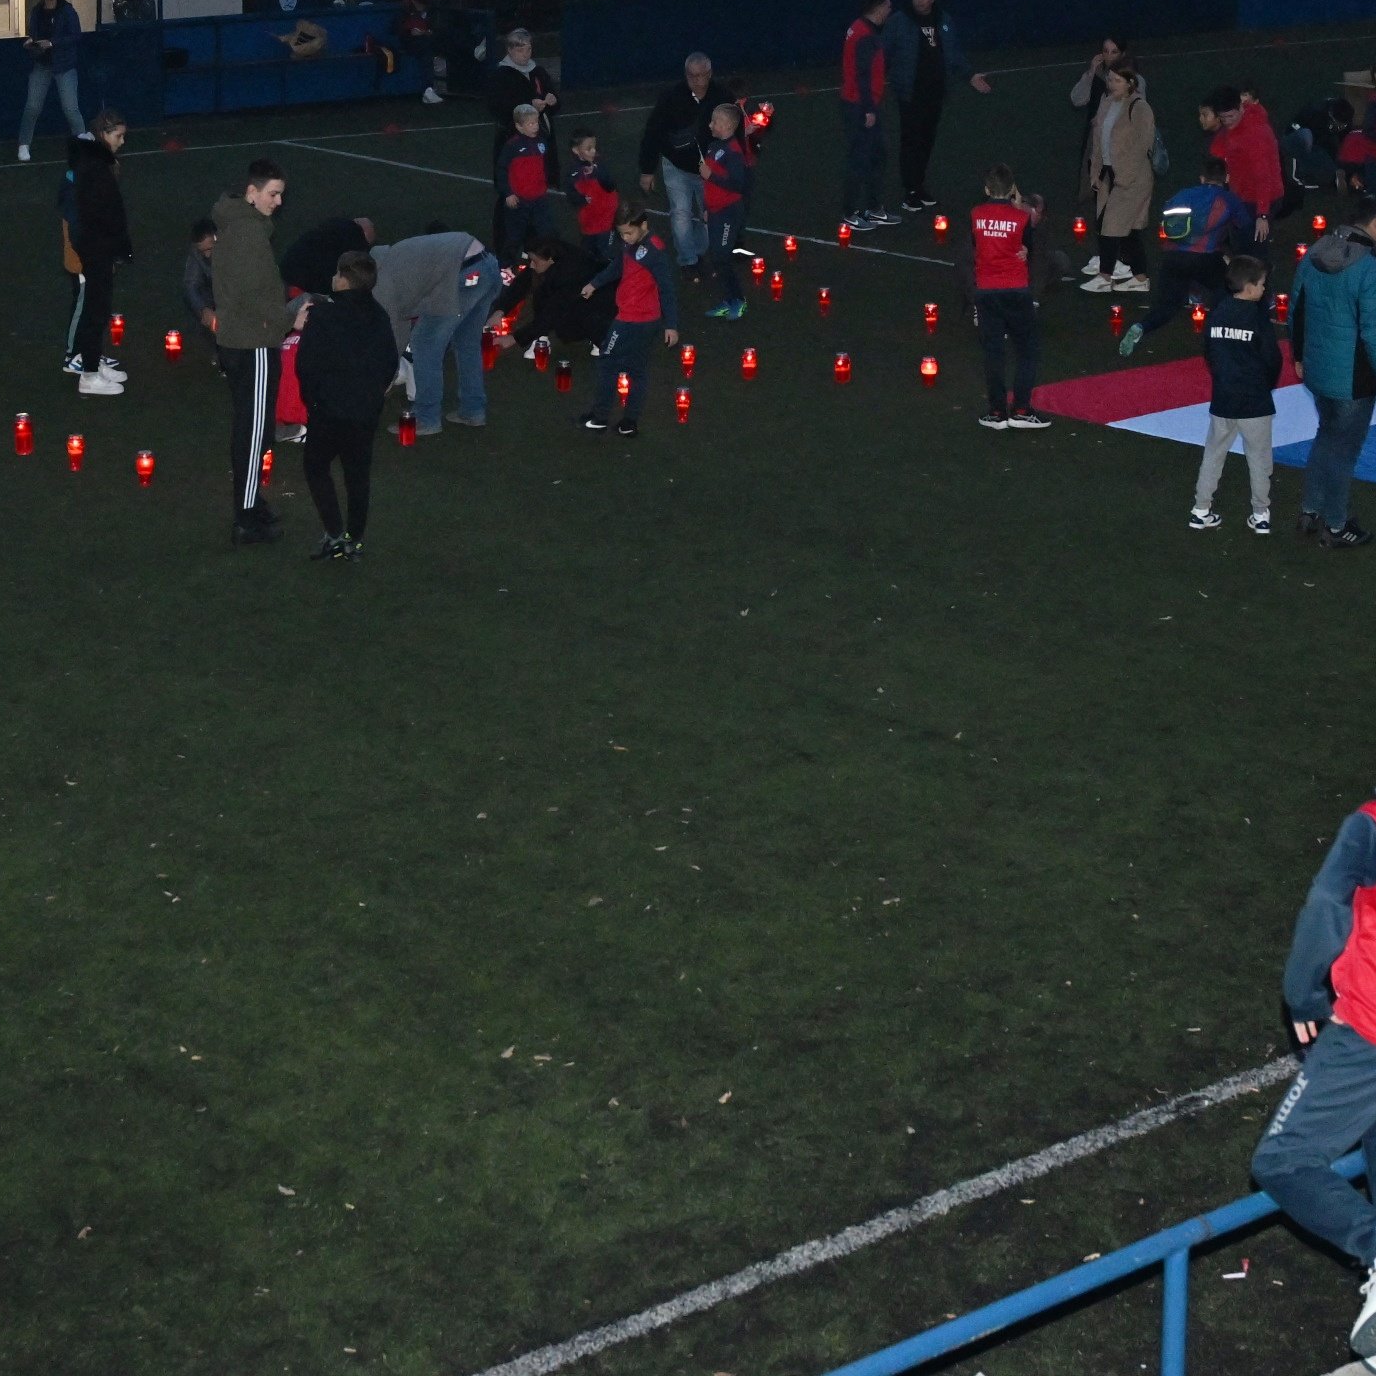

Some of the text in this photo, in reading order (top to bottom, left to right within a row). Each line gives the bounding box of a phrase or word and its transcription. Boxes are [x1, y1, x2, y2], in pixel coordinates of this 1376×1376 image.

[976, 218, 1018, 233] NK ZAMET
[1210, 326, 1255, 342] NK ZAMET
